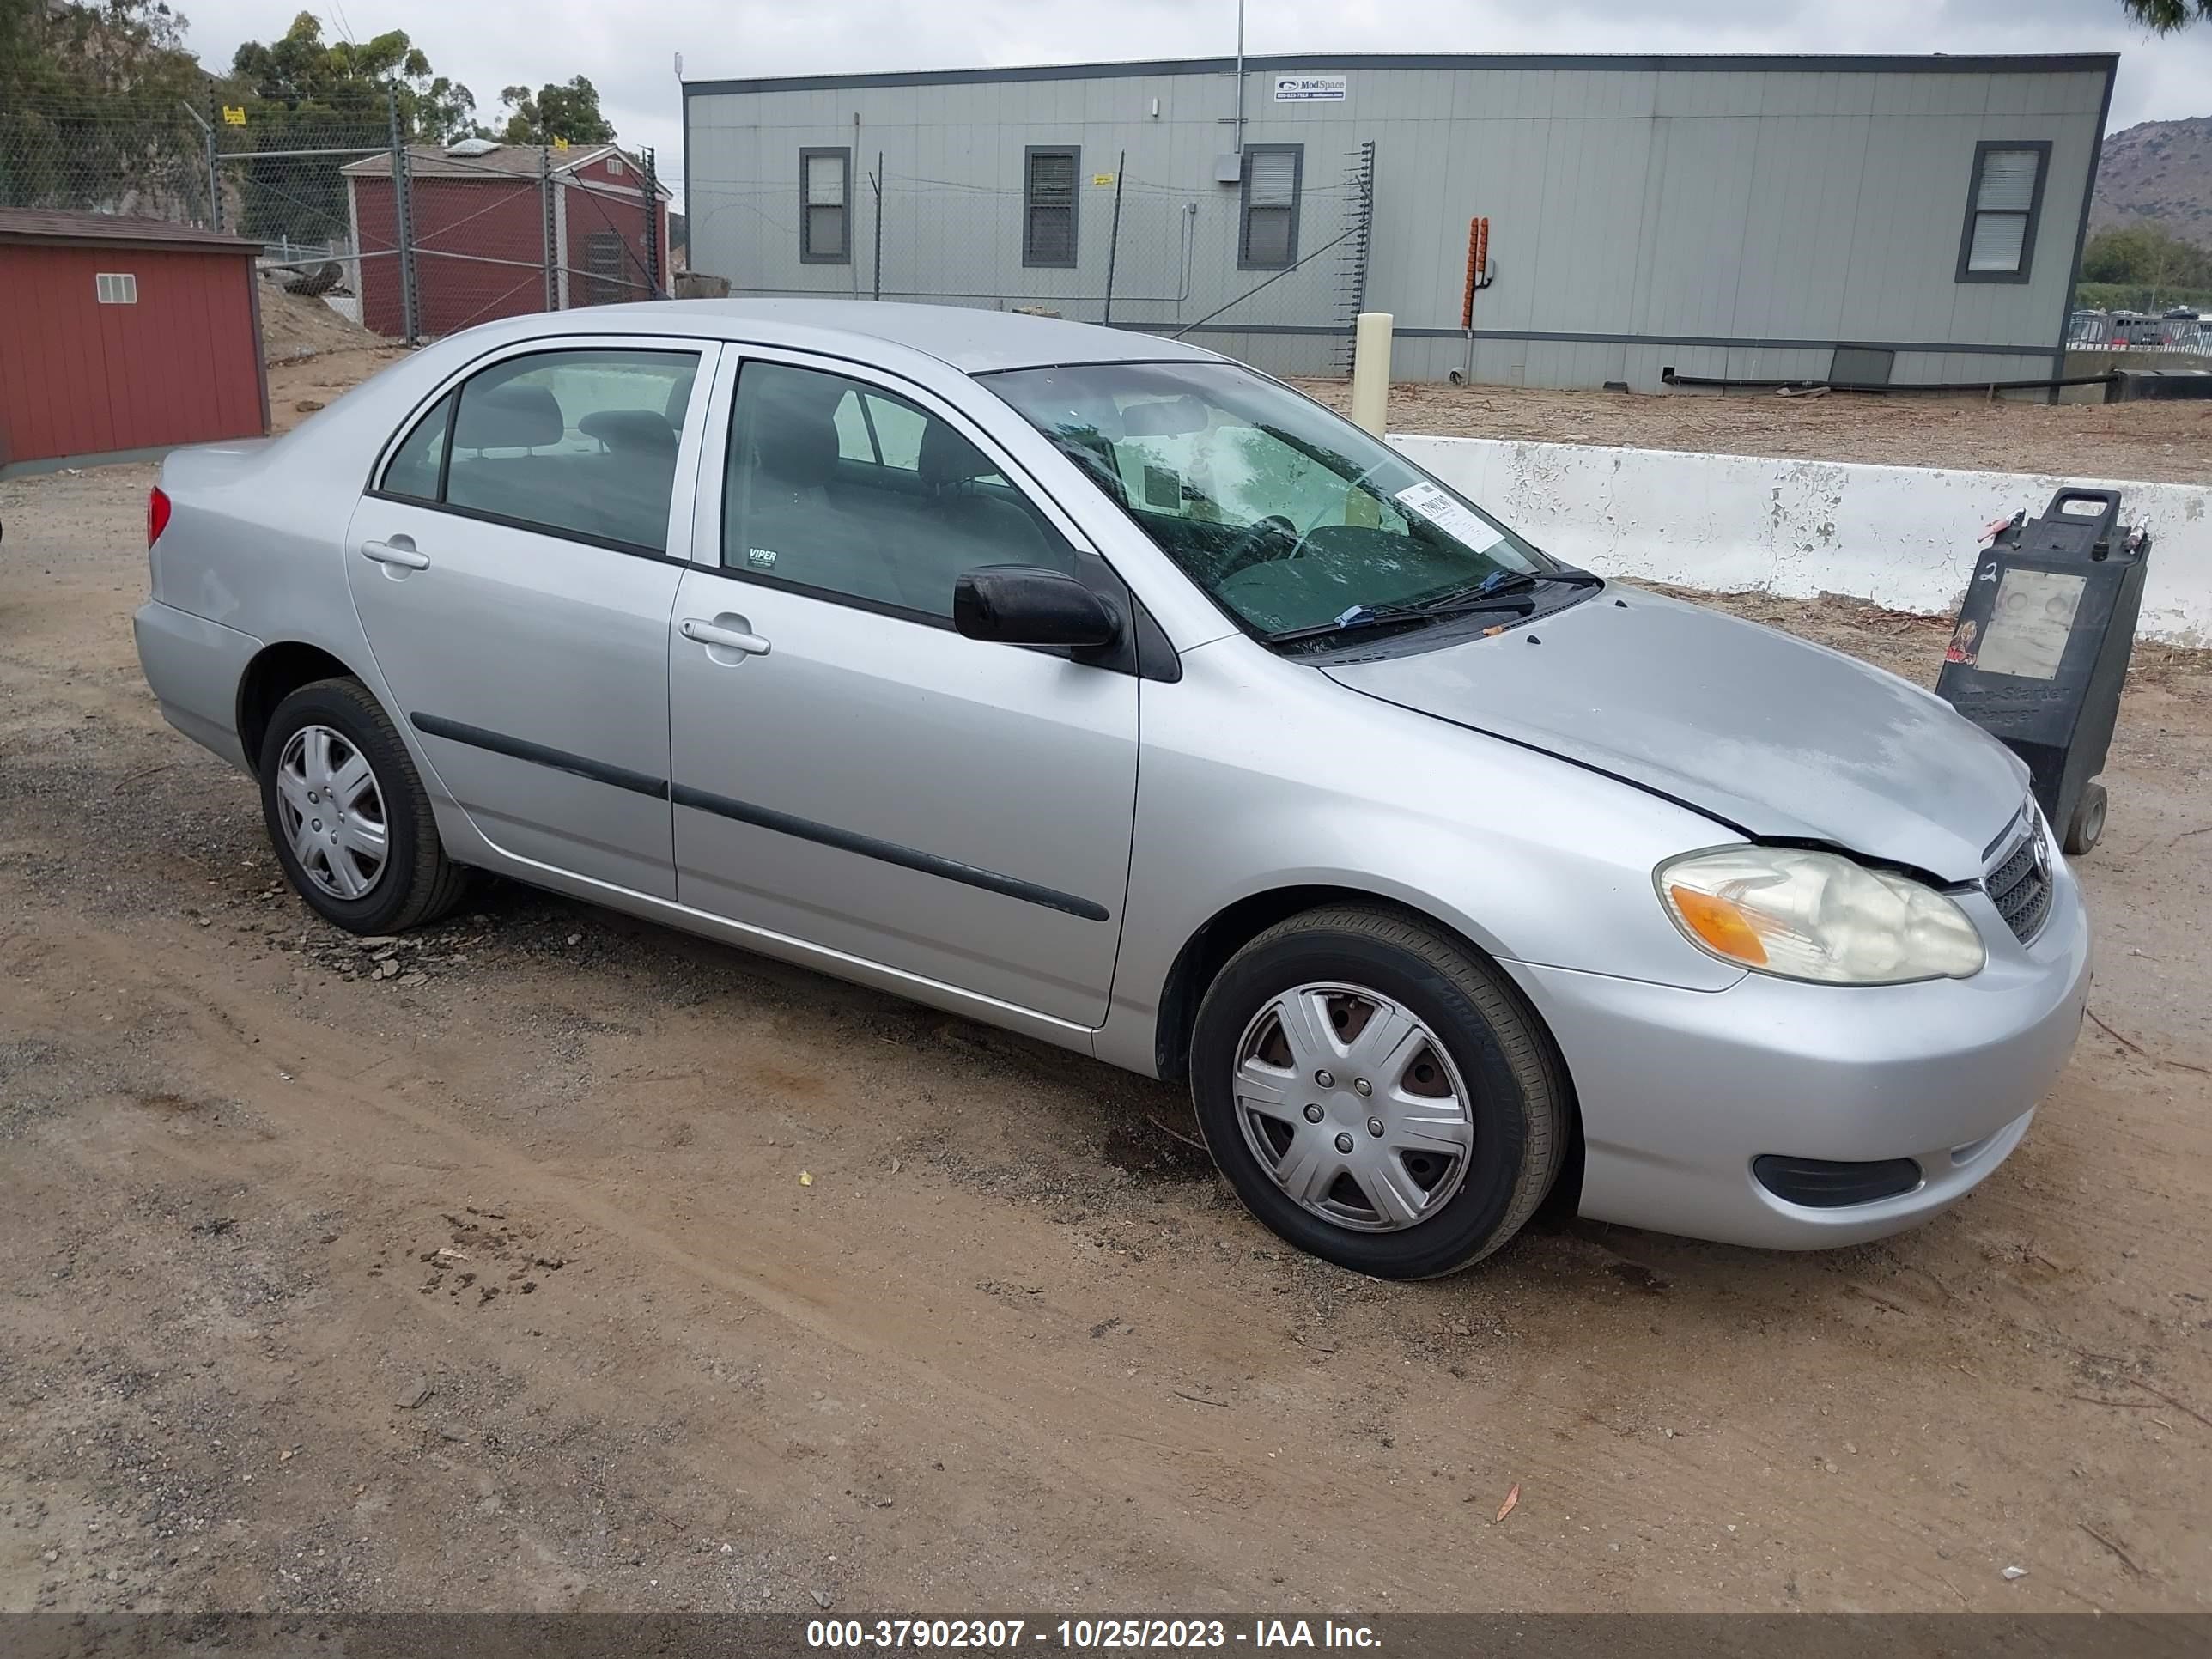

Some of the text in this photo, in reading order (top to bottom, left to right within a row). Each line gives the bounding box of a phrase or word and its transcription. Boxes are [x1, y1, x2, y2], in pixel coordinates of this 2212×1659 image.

[1300, 80, 1345, 90] ModSpace
[750, 548, 776, 561] VIPER
[1979, 562, 1997, 582] 2
